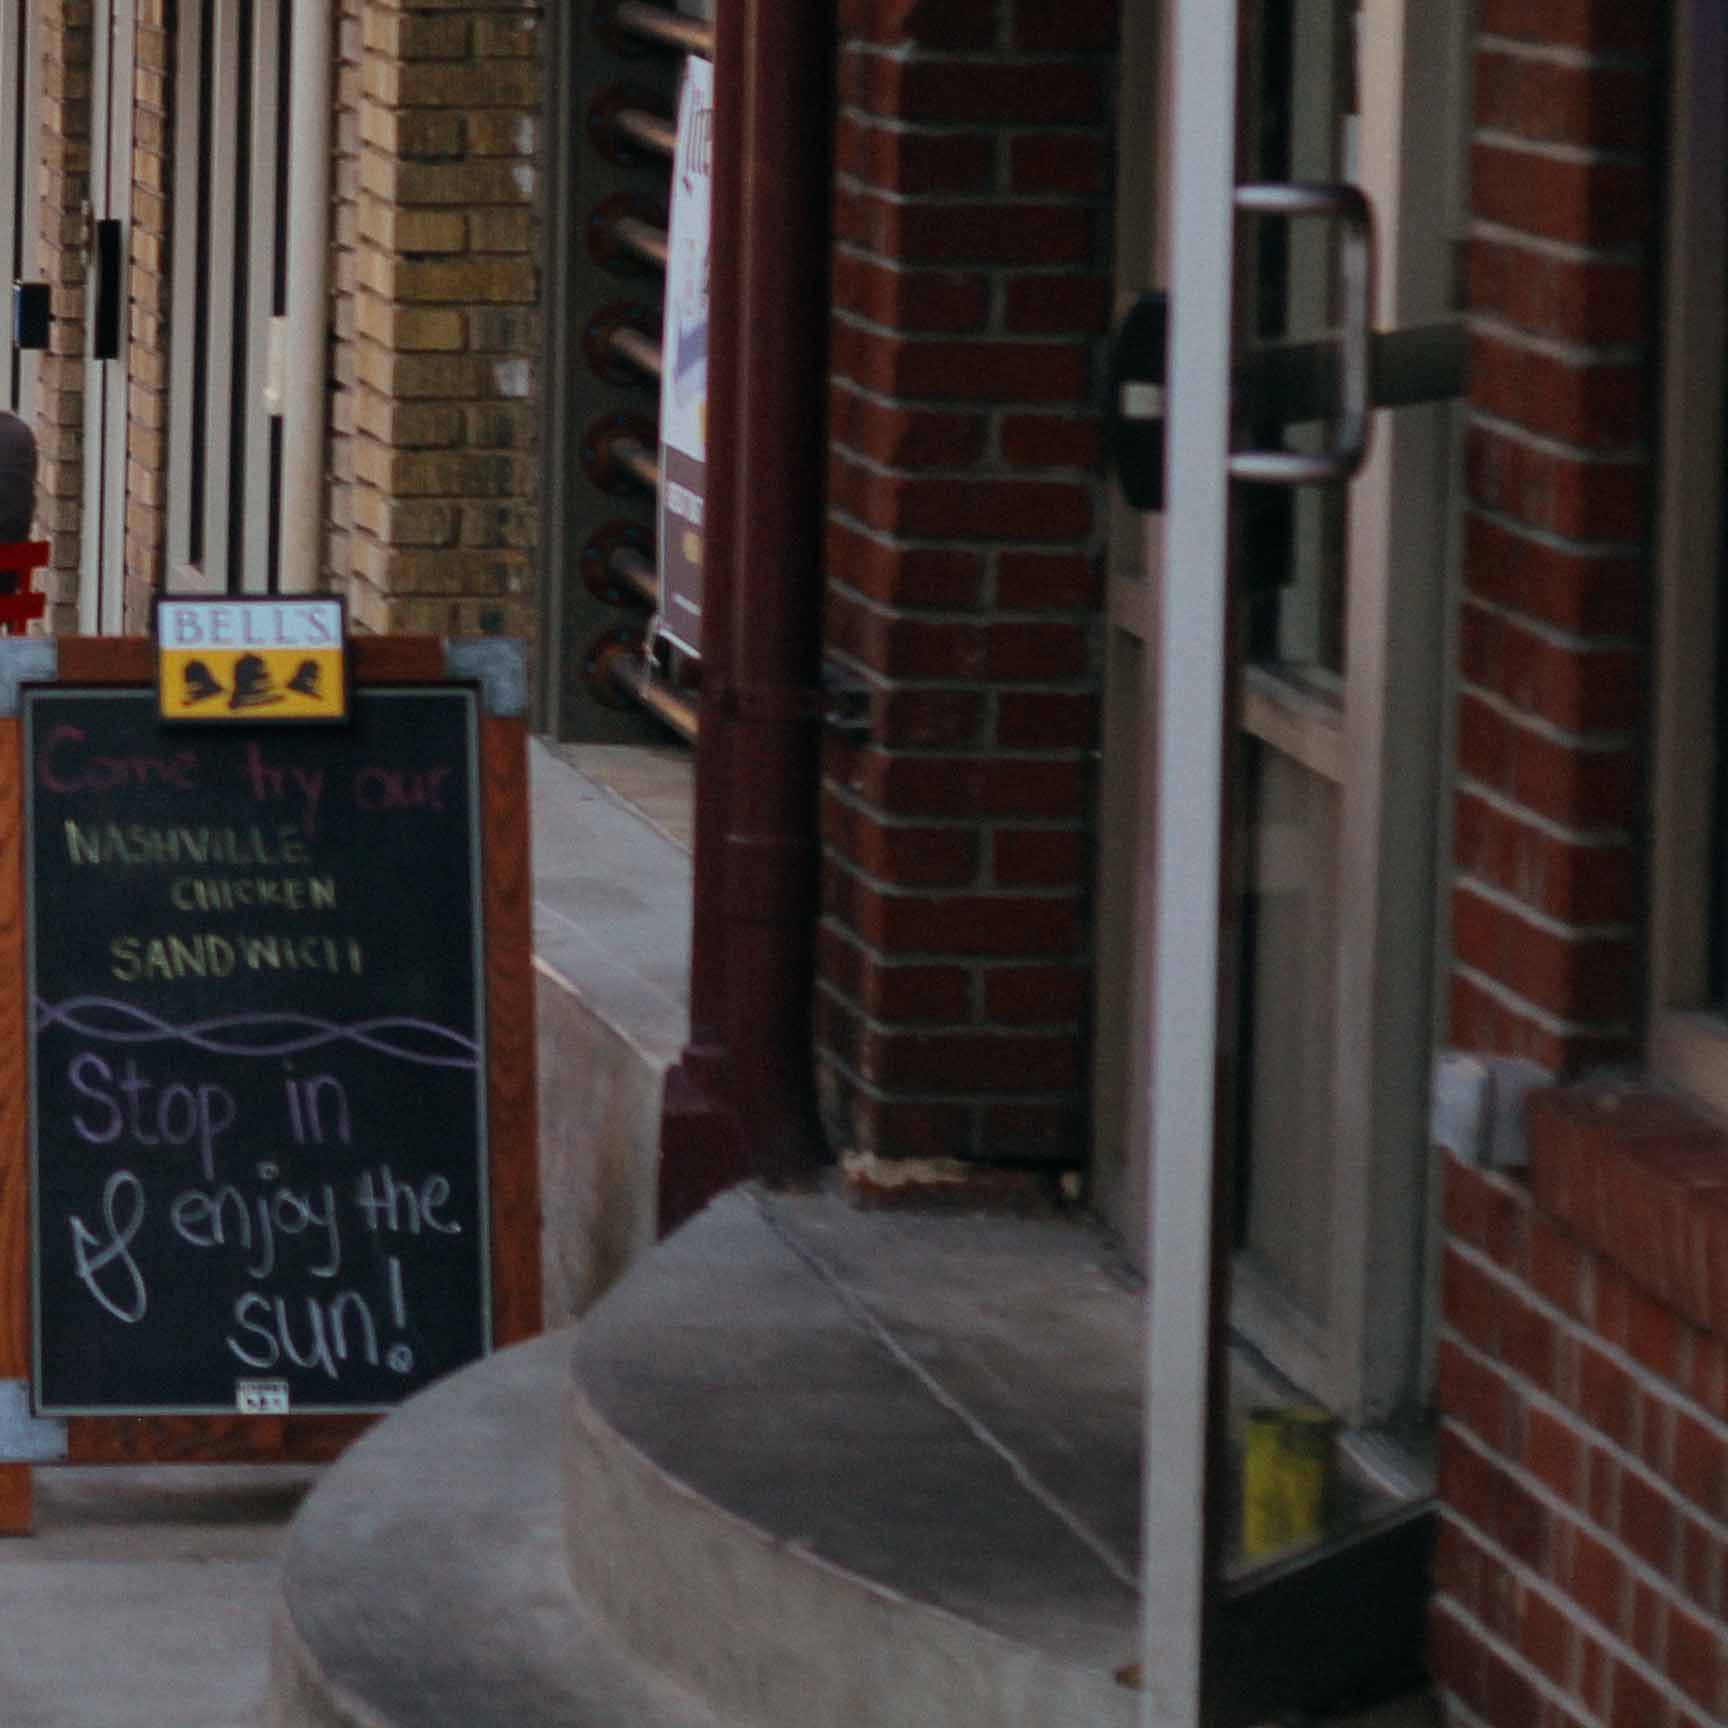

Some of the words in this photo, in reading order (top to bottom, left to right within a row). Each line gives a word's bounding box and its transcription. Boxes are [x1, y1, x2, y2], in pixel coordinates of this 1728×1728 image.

[173, 605, 335, 645] BELL'S
[63, 817, 315, 867] NASHVILLE
[170, 876, 337, 913] CHICKEN
[67, 1052, 236, 1179] Stop
[281, 1060, 353, 1145] in
[170, 1161, 342, 1278] enjoy
[357, 1163, 462, 1234] the
[225, 1257, 415, 1378] sun!
